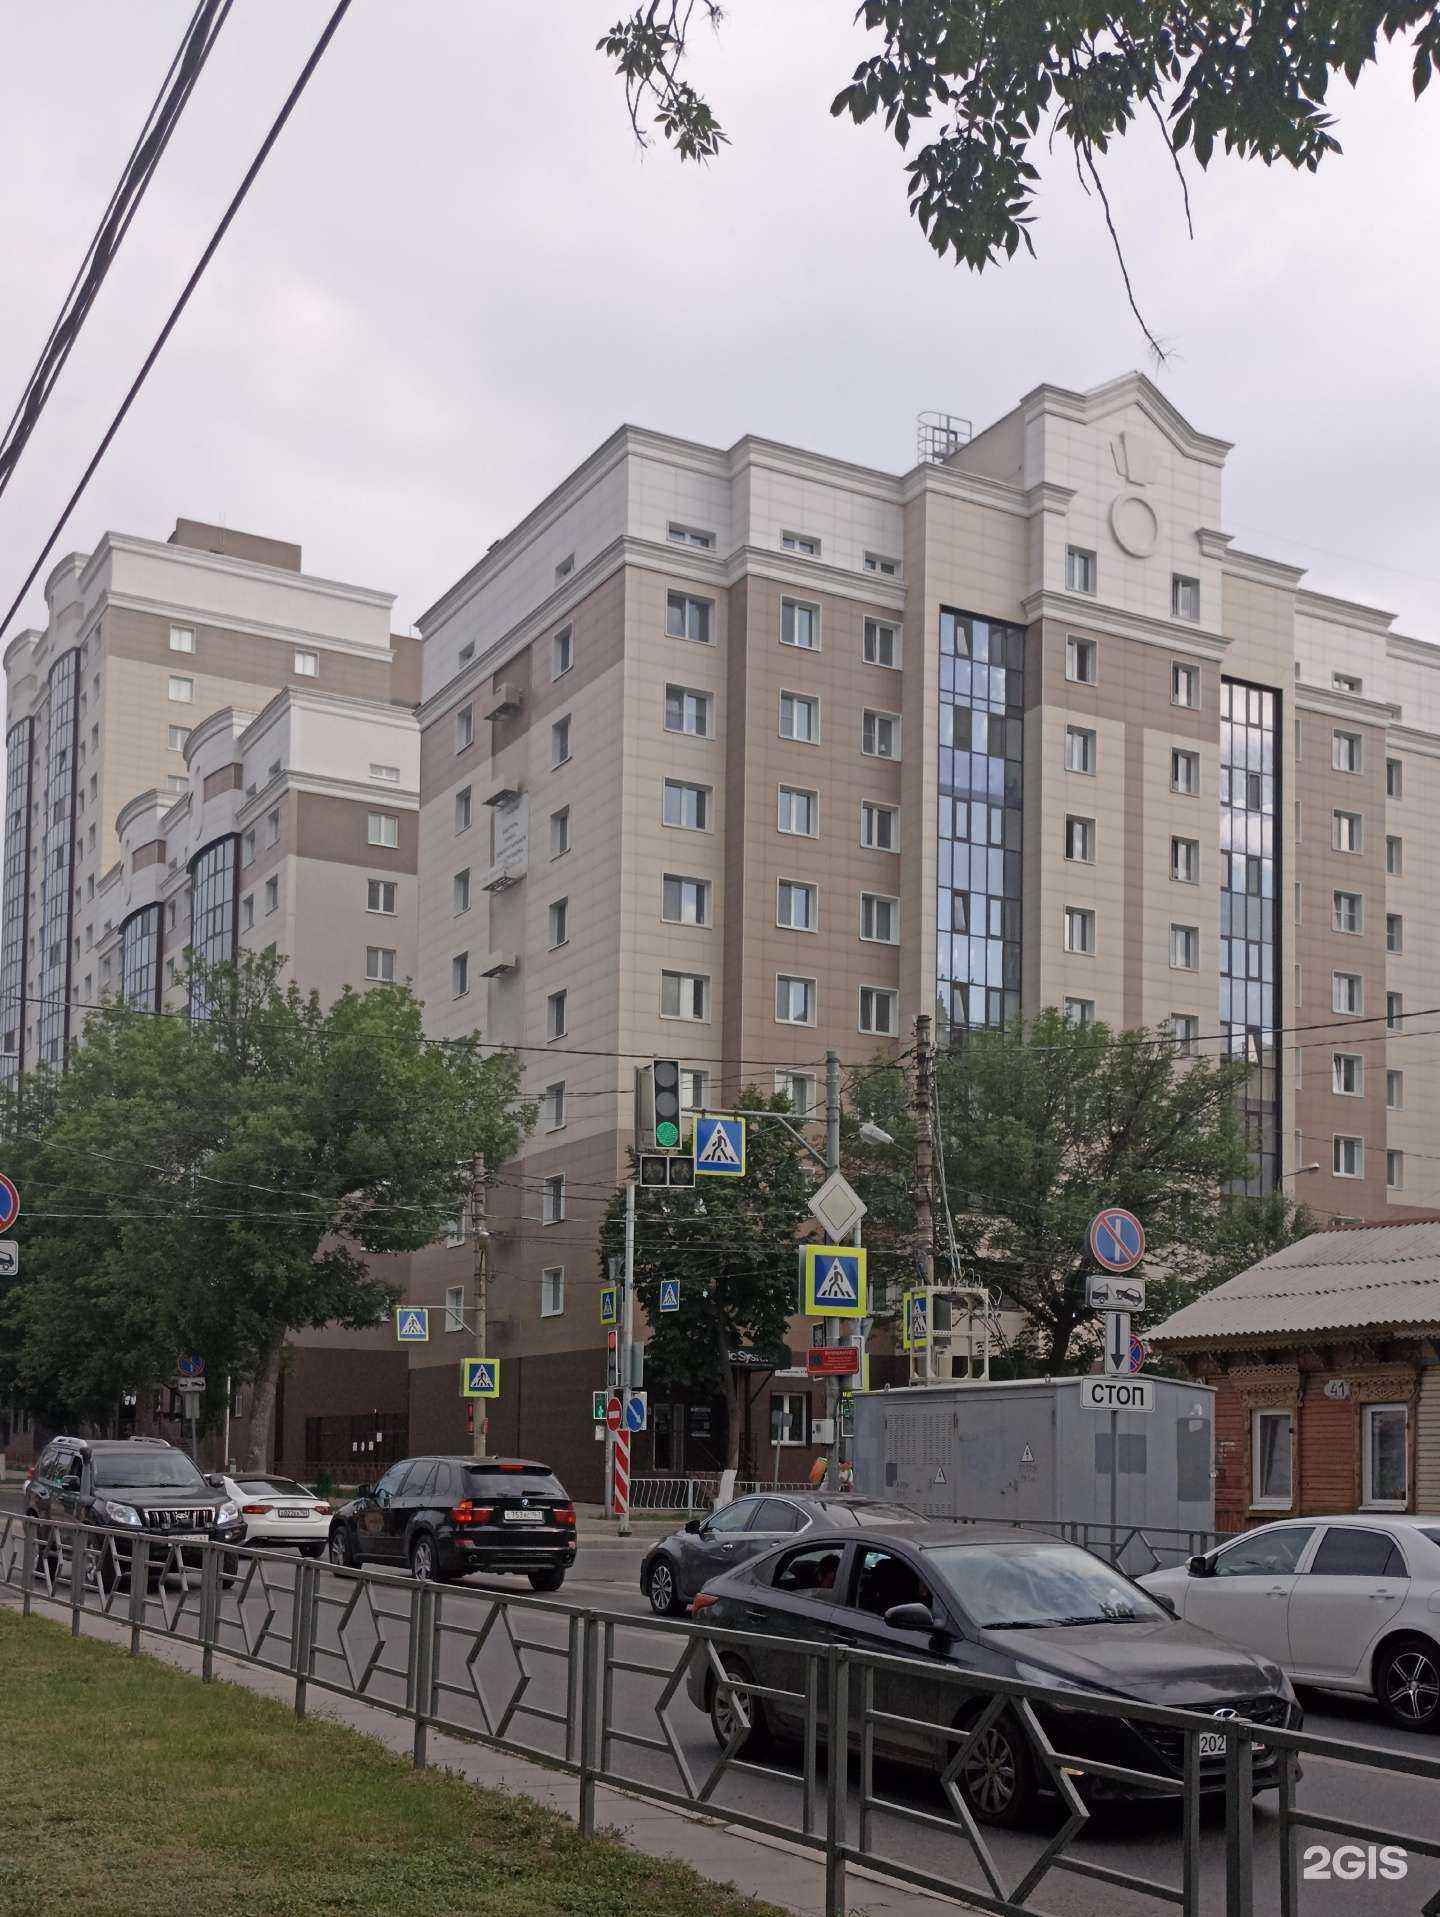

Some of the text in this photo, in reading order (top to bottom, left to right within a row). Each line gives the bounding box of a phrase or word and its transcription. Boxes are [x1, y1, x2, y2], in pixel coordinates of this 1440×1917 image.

[1091, 1383, 1145, 1406] СТОП
[1329, 1381, 1345, 1398] 41
[1200, 1735, 1225, 1753] 202
